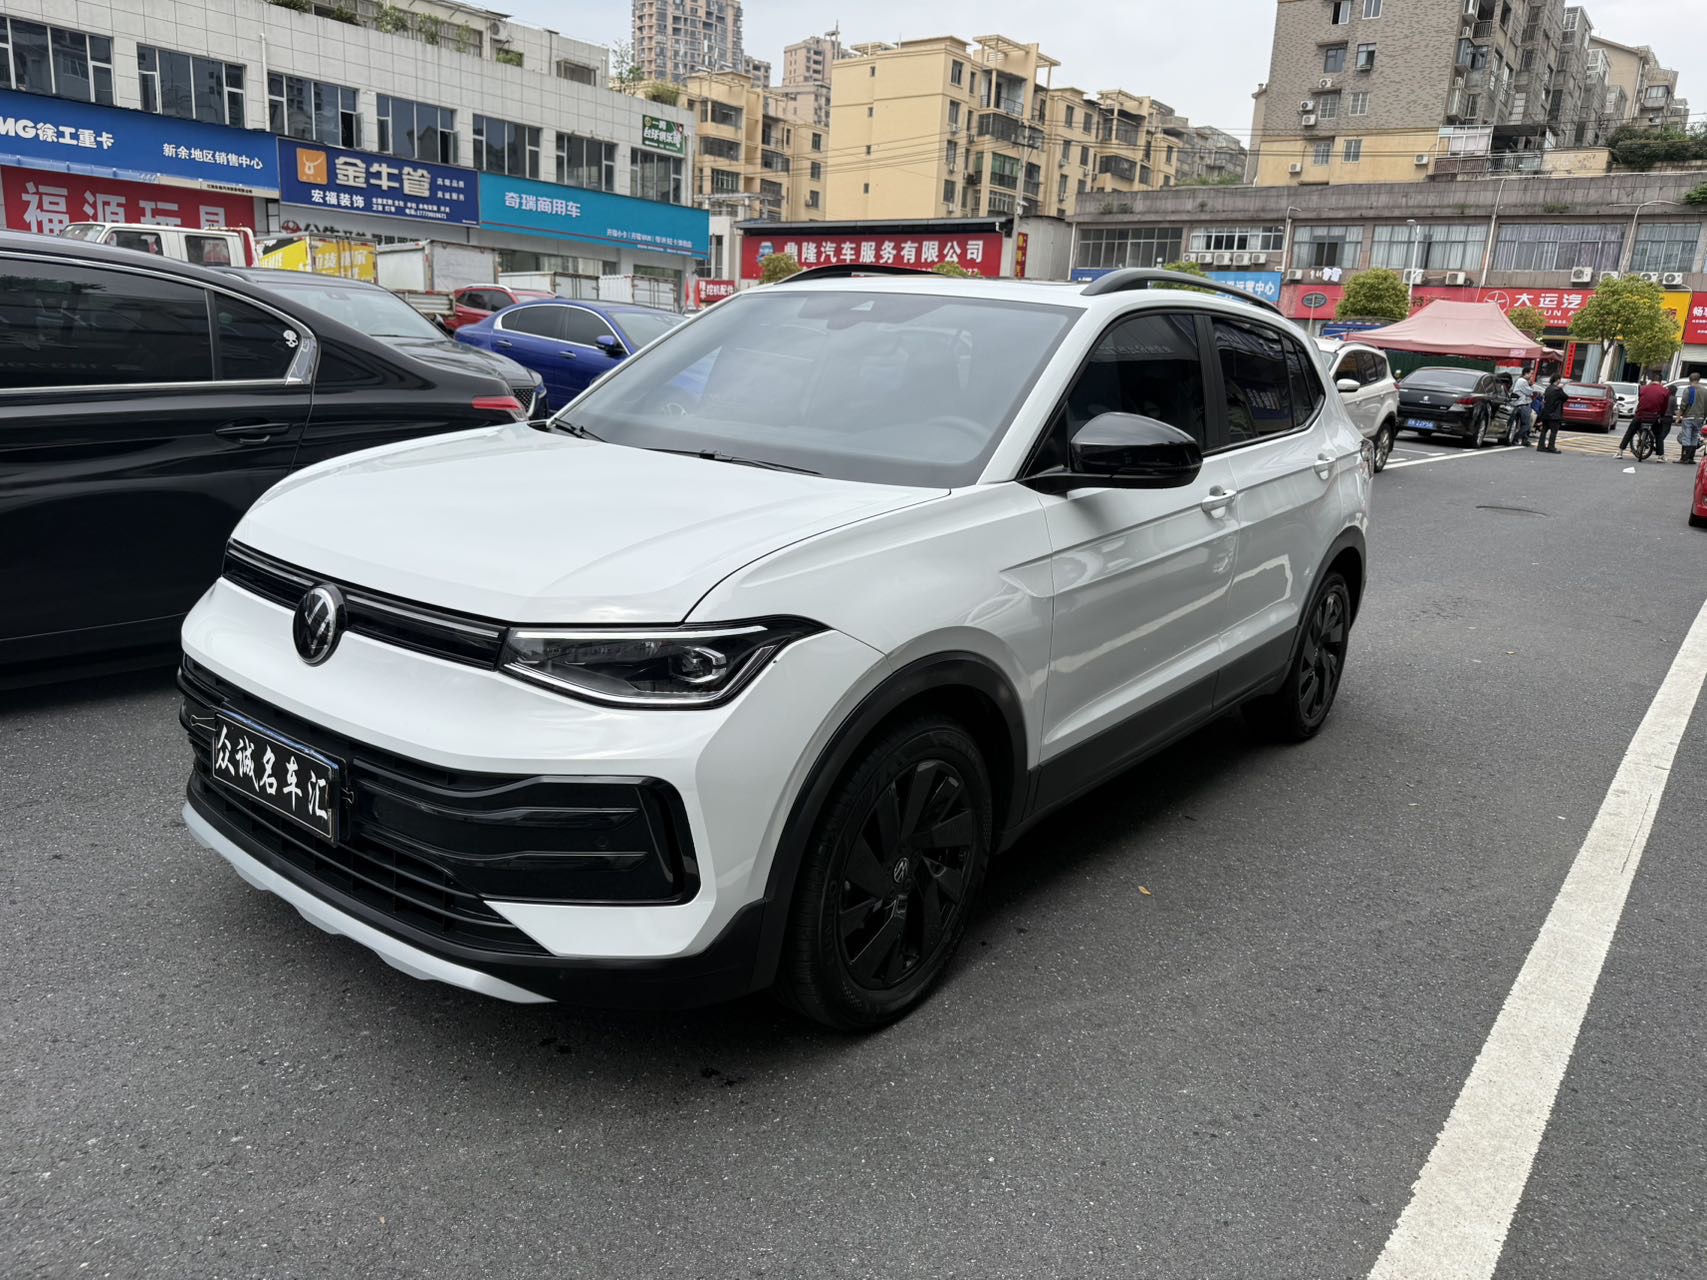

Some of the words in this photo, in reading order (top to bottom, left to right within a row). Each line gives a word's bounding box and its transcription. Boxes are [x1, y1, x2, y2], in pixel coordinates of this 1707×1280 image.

[162, 143, 264, 170] 新余地区销售中心
[334, 156, 432, 198] 金牛管
[311, 188, 366, 209] 宏福装饰
[504, 191, 582, 219] 奇瑞商用车
[783, 239, 984, 264] 鼎隆汽车服务有限公司
[1514, 292, 1588, 309] 大运汽
[216, 724, 328, 820] 众诚名车汇
